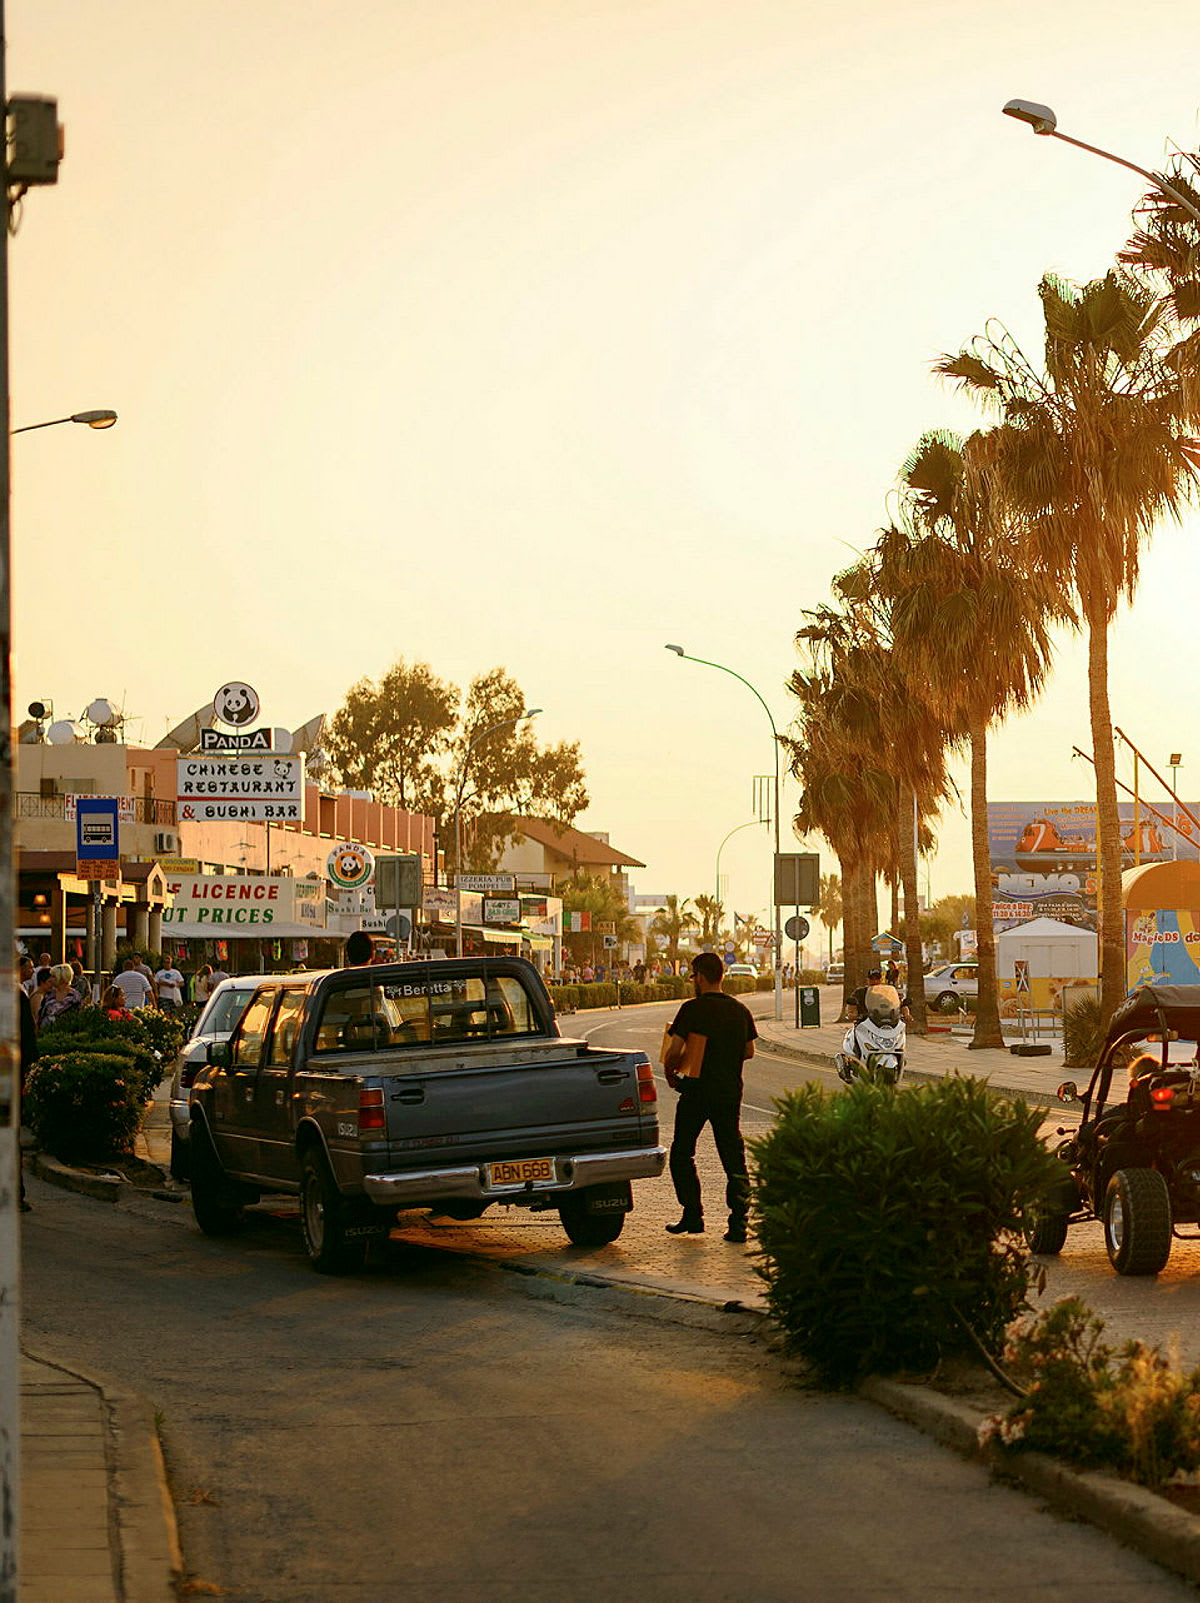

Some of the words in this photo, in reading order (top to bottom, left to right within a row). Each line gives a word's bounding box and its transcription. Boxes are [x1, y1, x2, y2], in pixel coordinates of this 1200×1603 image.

[204, 732, 268, 748] PANDA
[187, 763, 263, 776] CHINESE
[184, 781, 296, 793] RESTAURANT
[182, 804, 195, 819] &
[205, 805, 256, 818] SUSHI
[264, 805, 297, 818] BAR
[332, 845, 366, 857] PANDA
[998, 873, 1080, 893] NEMO
[192, 883, 279, 899] LICENCE
[162, 907, 188, 922] UT
[197, 907, 274, 923] PRICES
[403, 983, 453, 996] Beretta
[494, 1164, 521, 1182] ABN
[522, 1161, 550, 1179] 668
[592, 1198, 629, 1210] ISUZU
